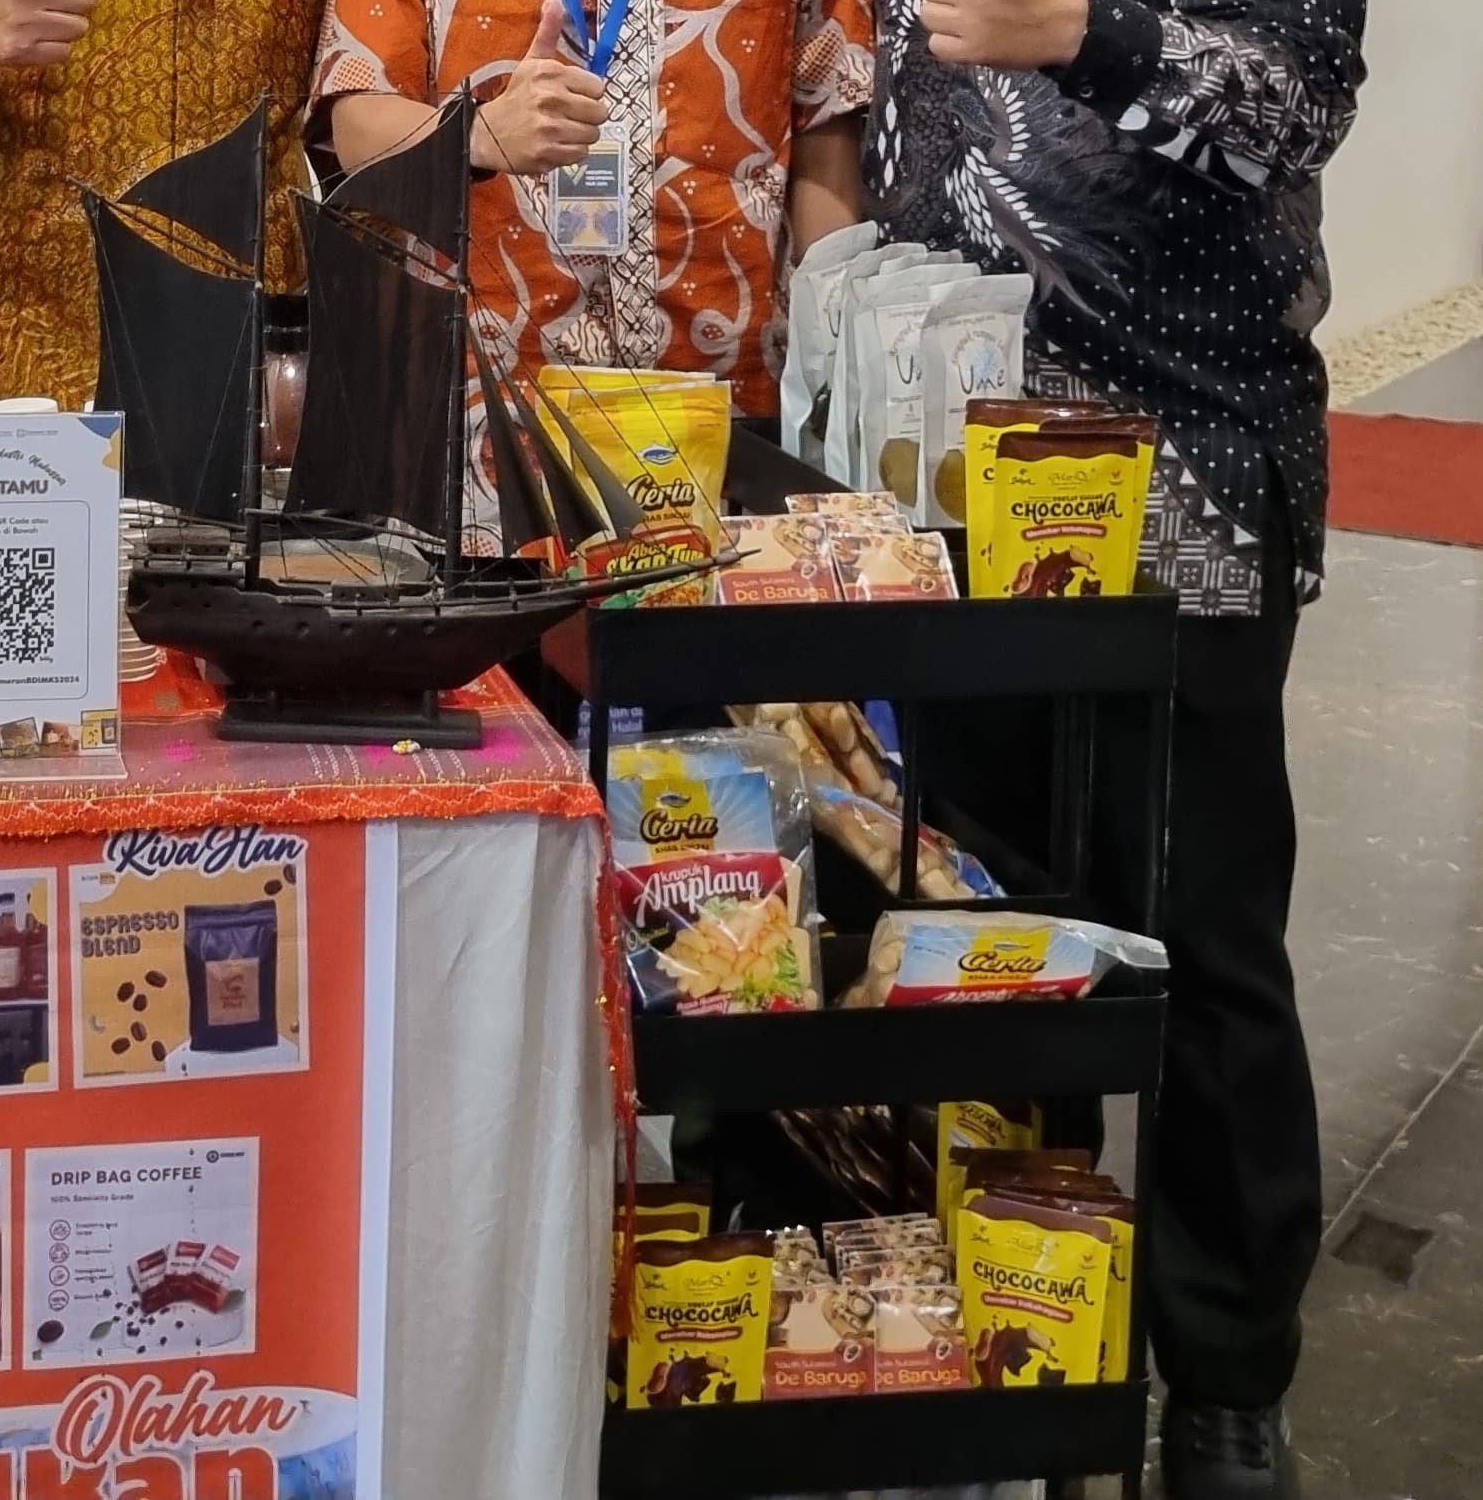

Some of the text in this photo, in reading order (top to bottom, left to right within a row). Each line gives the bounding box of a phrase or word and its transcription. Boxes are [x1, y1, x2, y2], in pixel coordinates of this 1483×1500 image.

[958, 364, 1006, 395] Ume
[626, 473, 696, 511] Ceria
[9, 517, 29, 525] Code
[1010, 492, 1123, 526] CHOCOCAWA
[13, 527, 39, 535] Bawah
[734, 589, 759, 601] De
[640, 808, 719, 844] Ceria
[660, 865, 703, 883] krupuk
[634, 865, 763, 928] Amplang
[81, 910, 180, 937] ESPRESSO
[81, 934, 141, 959] BLEND
[958, 951, 1048, 974] Ceria
[50, 1166, 203, 1186] DRIP BAG COFFEE
[972, 1259, 1095, 1306] CHOCOCAWA
[646, 1292, 759, 1328] CHOCOCAWA
[775, 1370, 866, 1388] De Baruga
[898, 1368, 962, 1385] Baruga
[55, 1375, 296, 1465] Olahan
